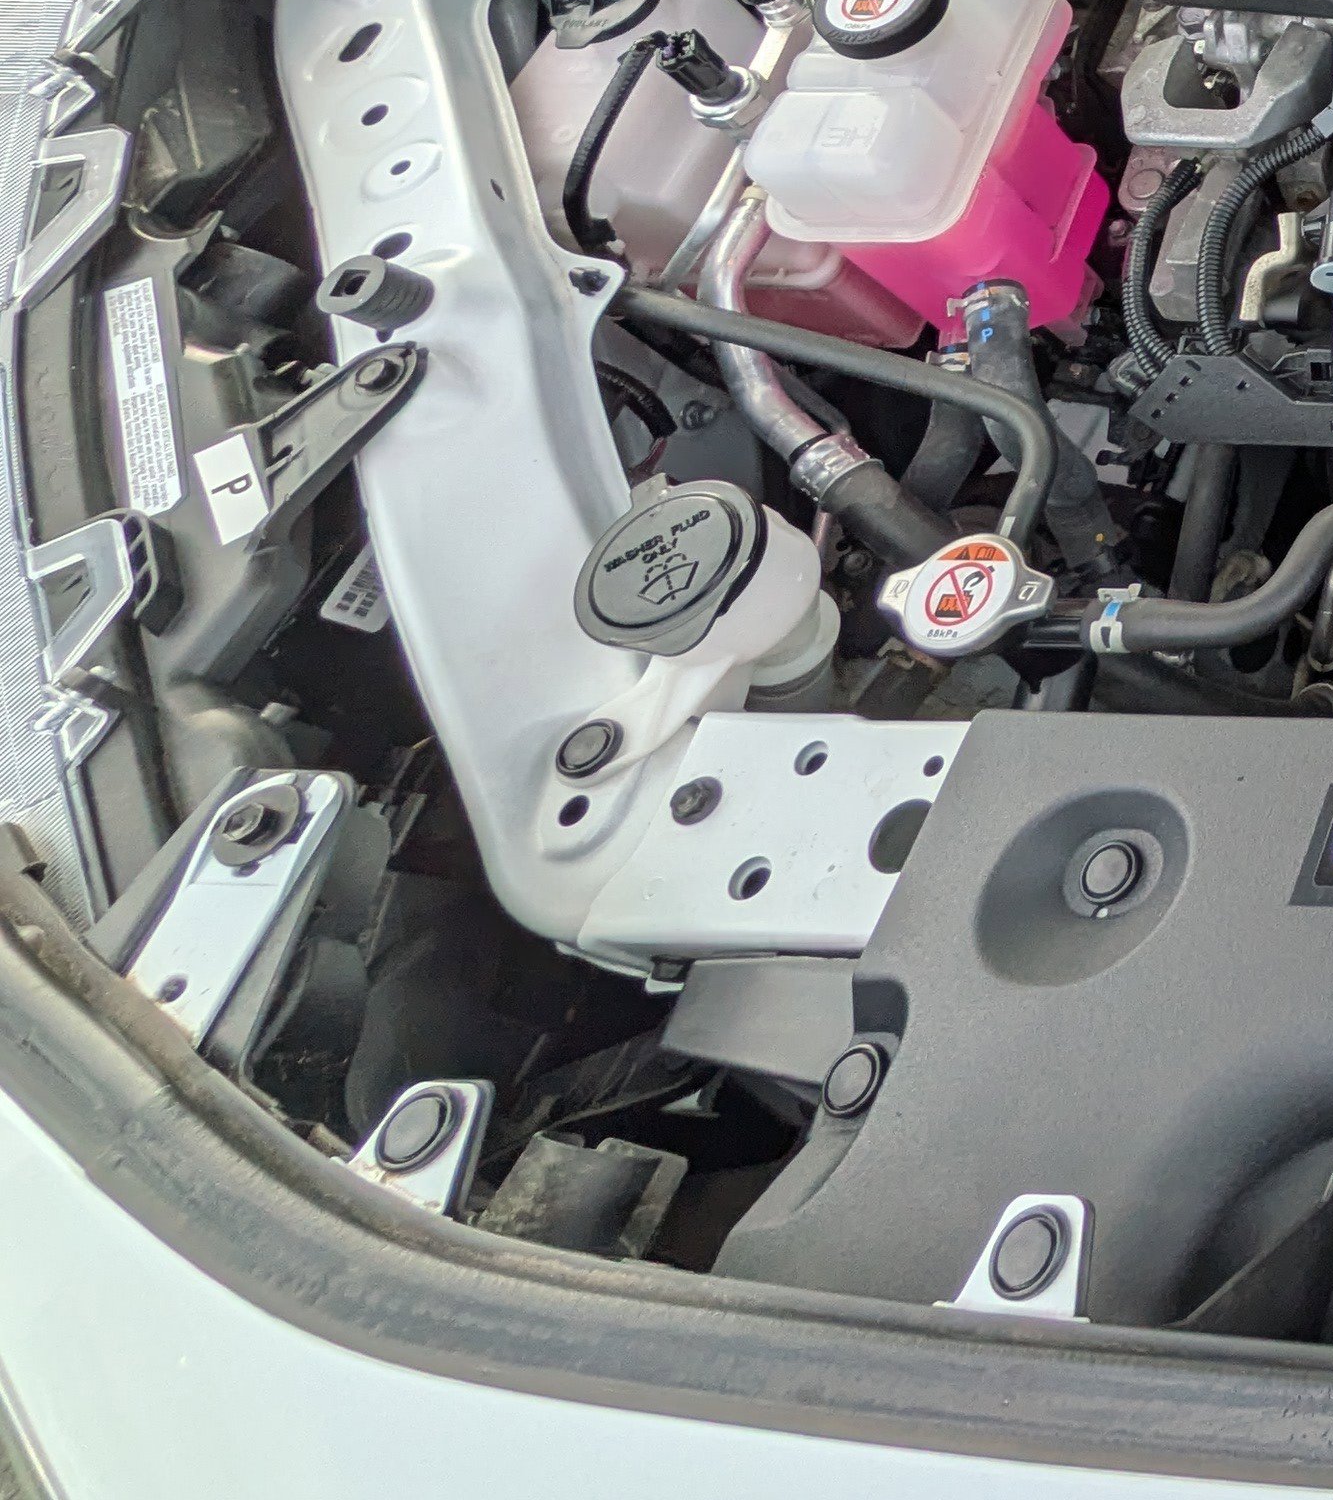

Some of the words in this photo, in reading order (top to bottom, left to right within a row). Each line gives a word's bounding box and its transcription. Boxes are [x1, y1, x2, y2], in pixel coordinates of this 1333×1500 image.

[211, 472, 253, 495] P
[603, 534, 664, 573] WASHER
[670, 509, 711, 537] FLUID
[641, 536, 679, 565] ONLY
